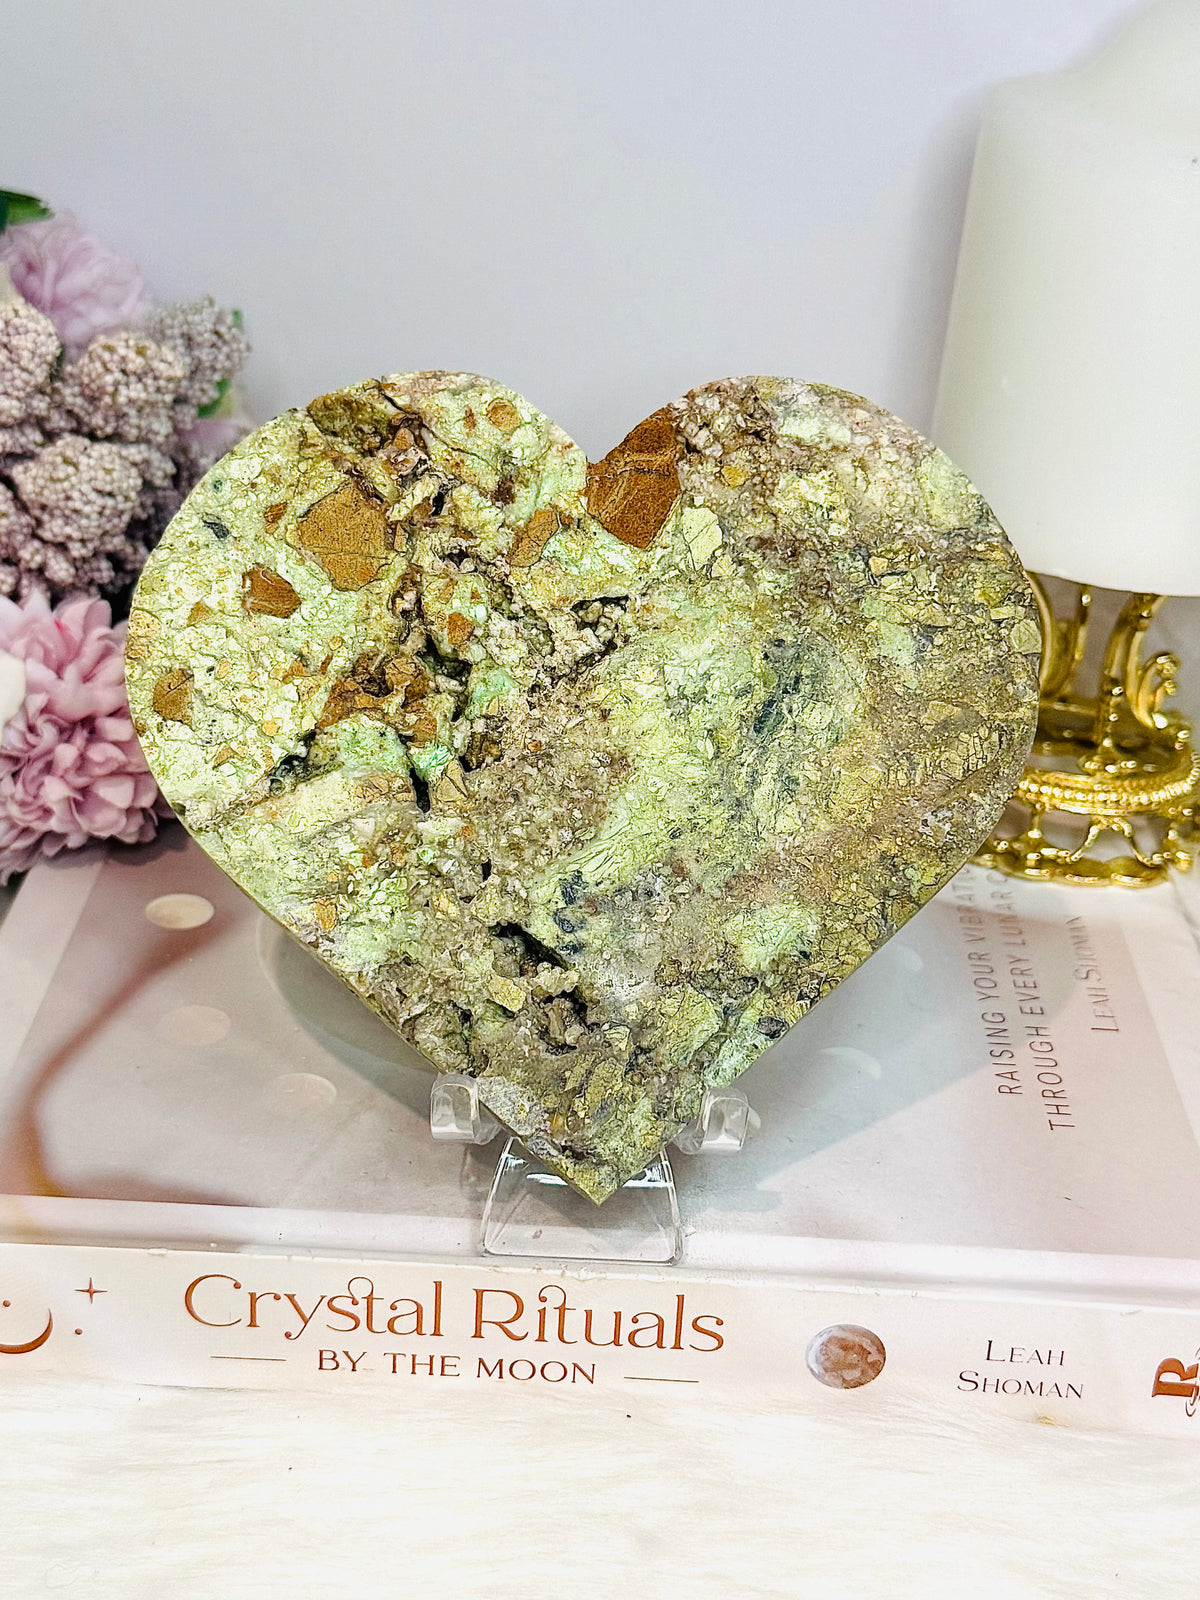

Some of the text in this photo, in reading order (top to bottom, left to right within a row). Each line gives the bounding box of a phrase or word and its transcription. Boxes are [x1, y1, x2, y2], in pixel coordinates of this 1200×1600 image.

[990, 891, 1027, 947] LUNAR
[967, 951, 1001, 1002] YOUR
[1009, 954, 1045, 1017] EVERY
[981, 1011, 1024, 1095] RAISING
[1024, 1024, 1076, 1131] THROUGH
[184, 1273, 725, 1353] Crystal Rituals
[317, 1348, 597, 1385] BY THE MOON
[985, 1339, 1065, 1367] LEAH
[957, 1370, 1083, 1400] SHOMAN
